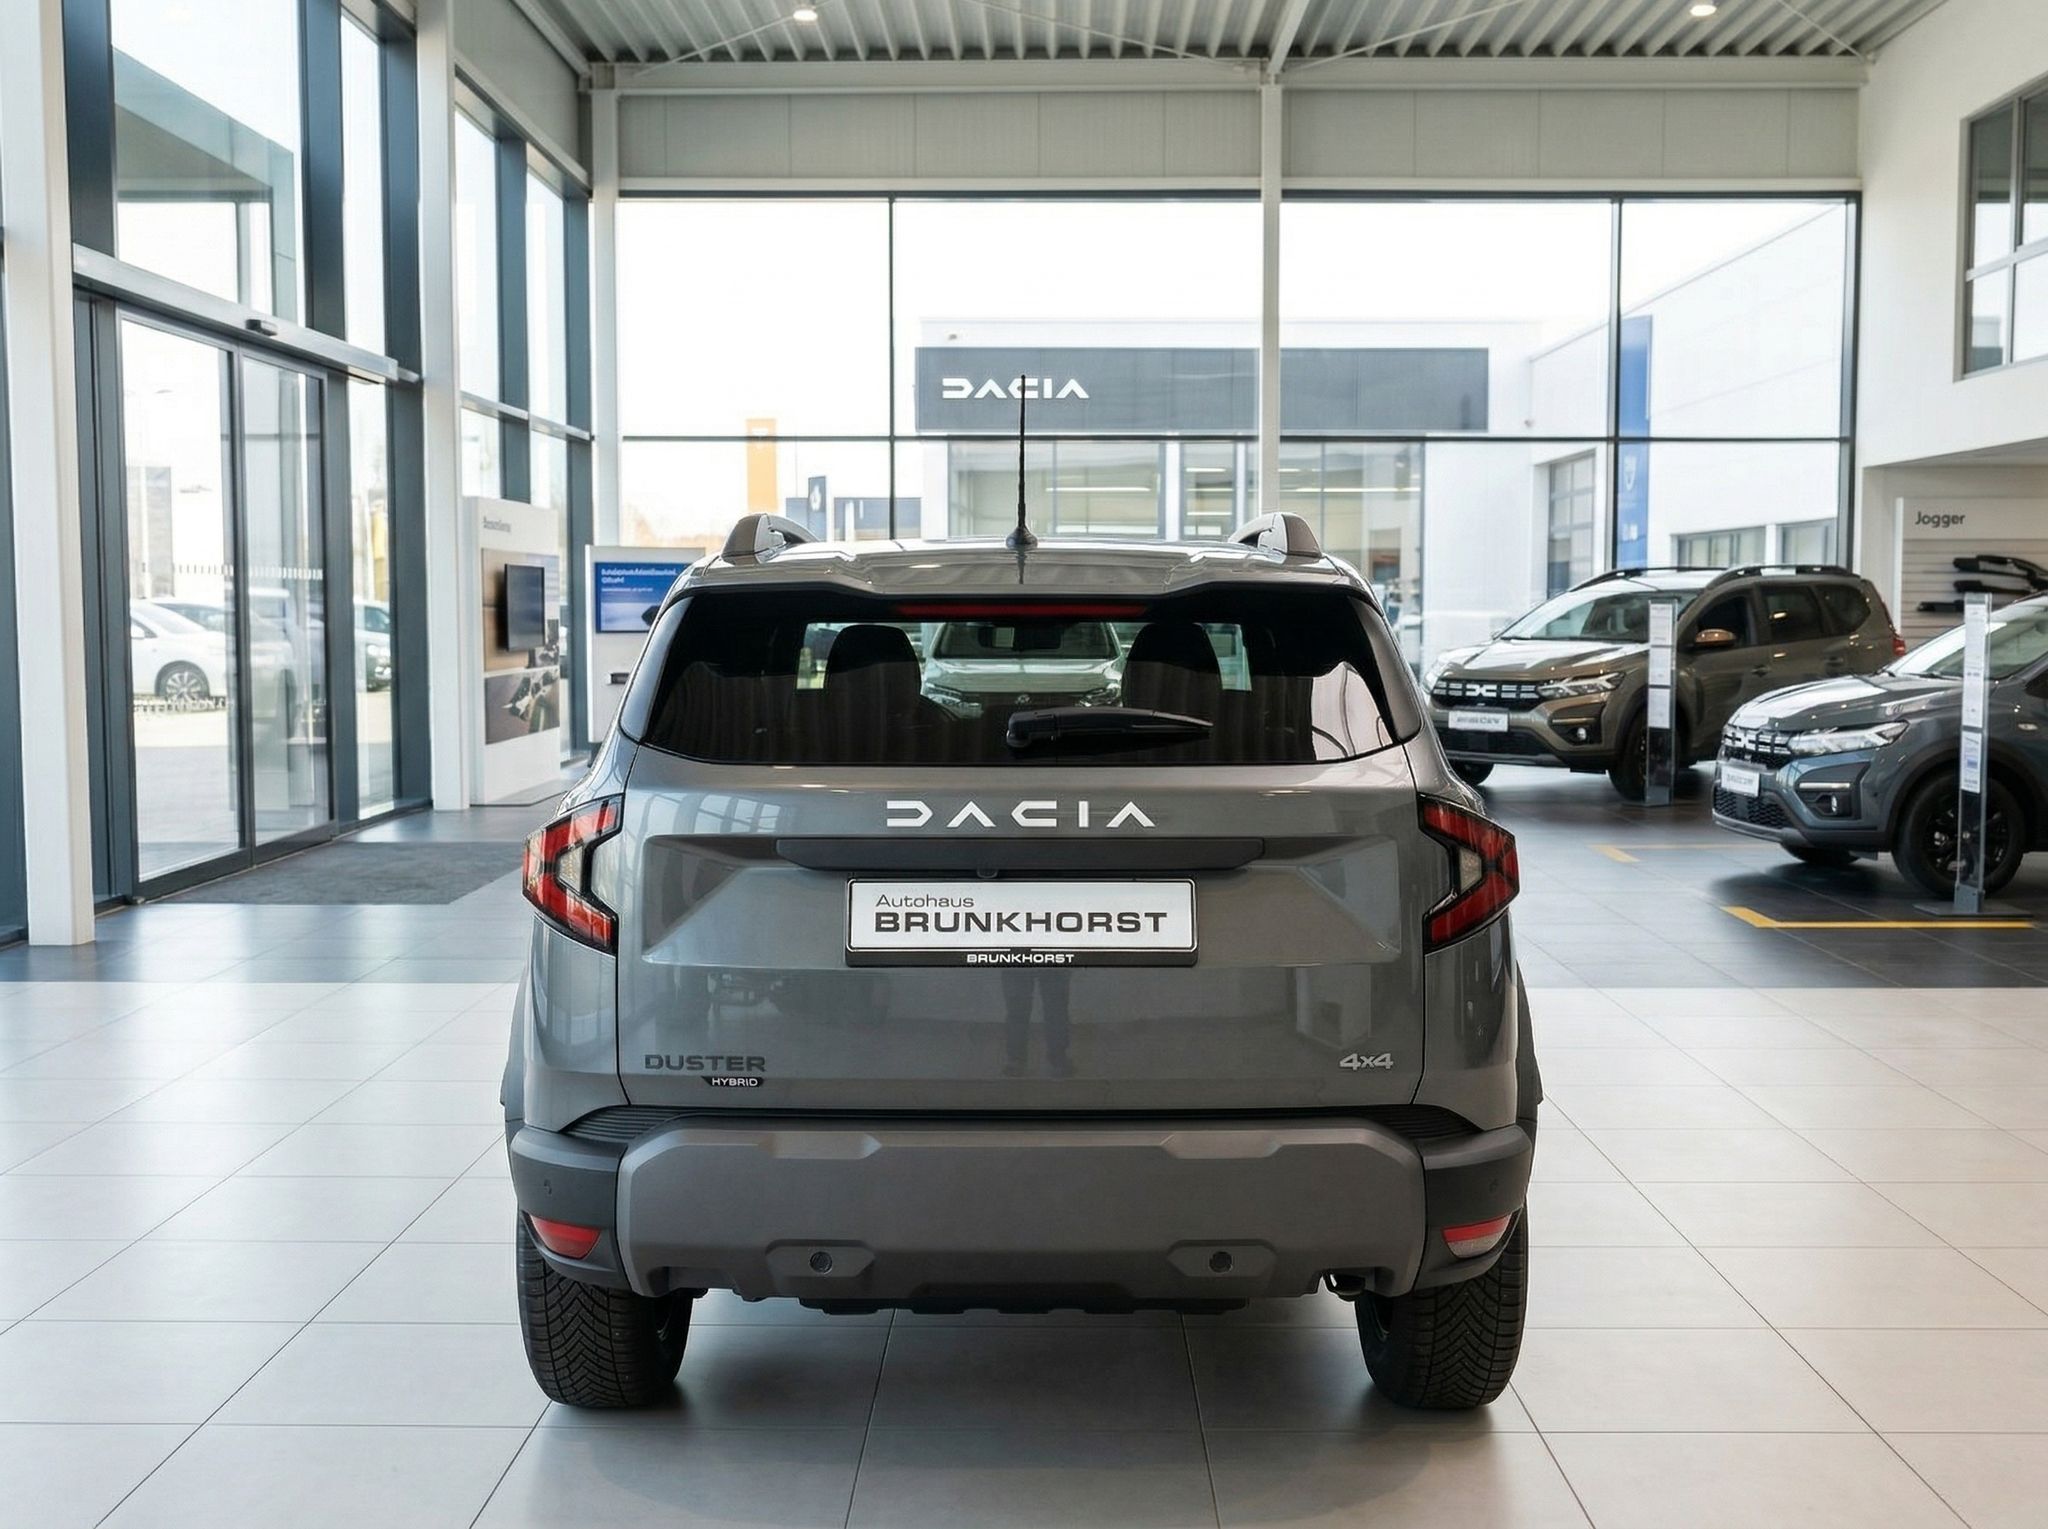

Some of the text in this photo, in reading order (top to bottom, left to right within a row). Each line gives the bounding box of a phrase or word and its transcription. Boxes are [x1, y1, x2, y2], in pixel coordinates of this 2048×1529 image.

[942, 378, 1090, 399] DACIA
[1915, 511, 1966, 528] Jogger
[886, 801, 1156, 828] DACIA
[875, 893, 975, 909] Autohaus
[874, 911, 1168, 933] BRUNKHORST
[967, 953, 1075, 965] BRUNKHORST
[645, 1054, 766, 1072] DUSTER
[1340, 1053, 1394, 1070] 4x4
[712, 1078, 759, 1087] HYBRID
